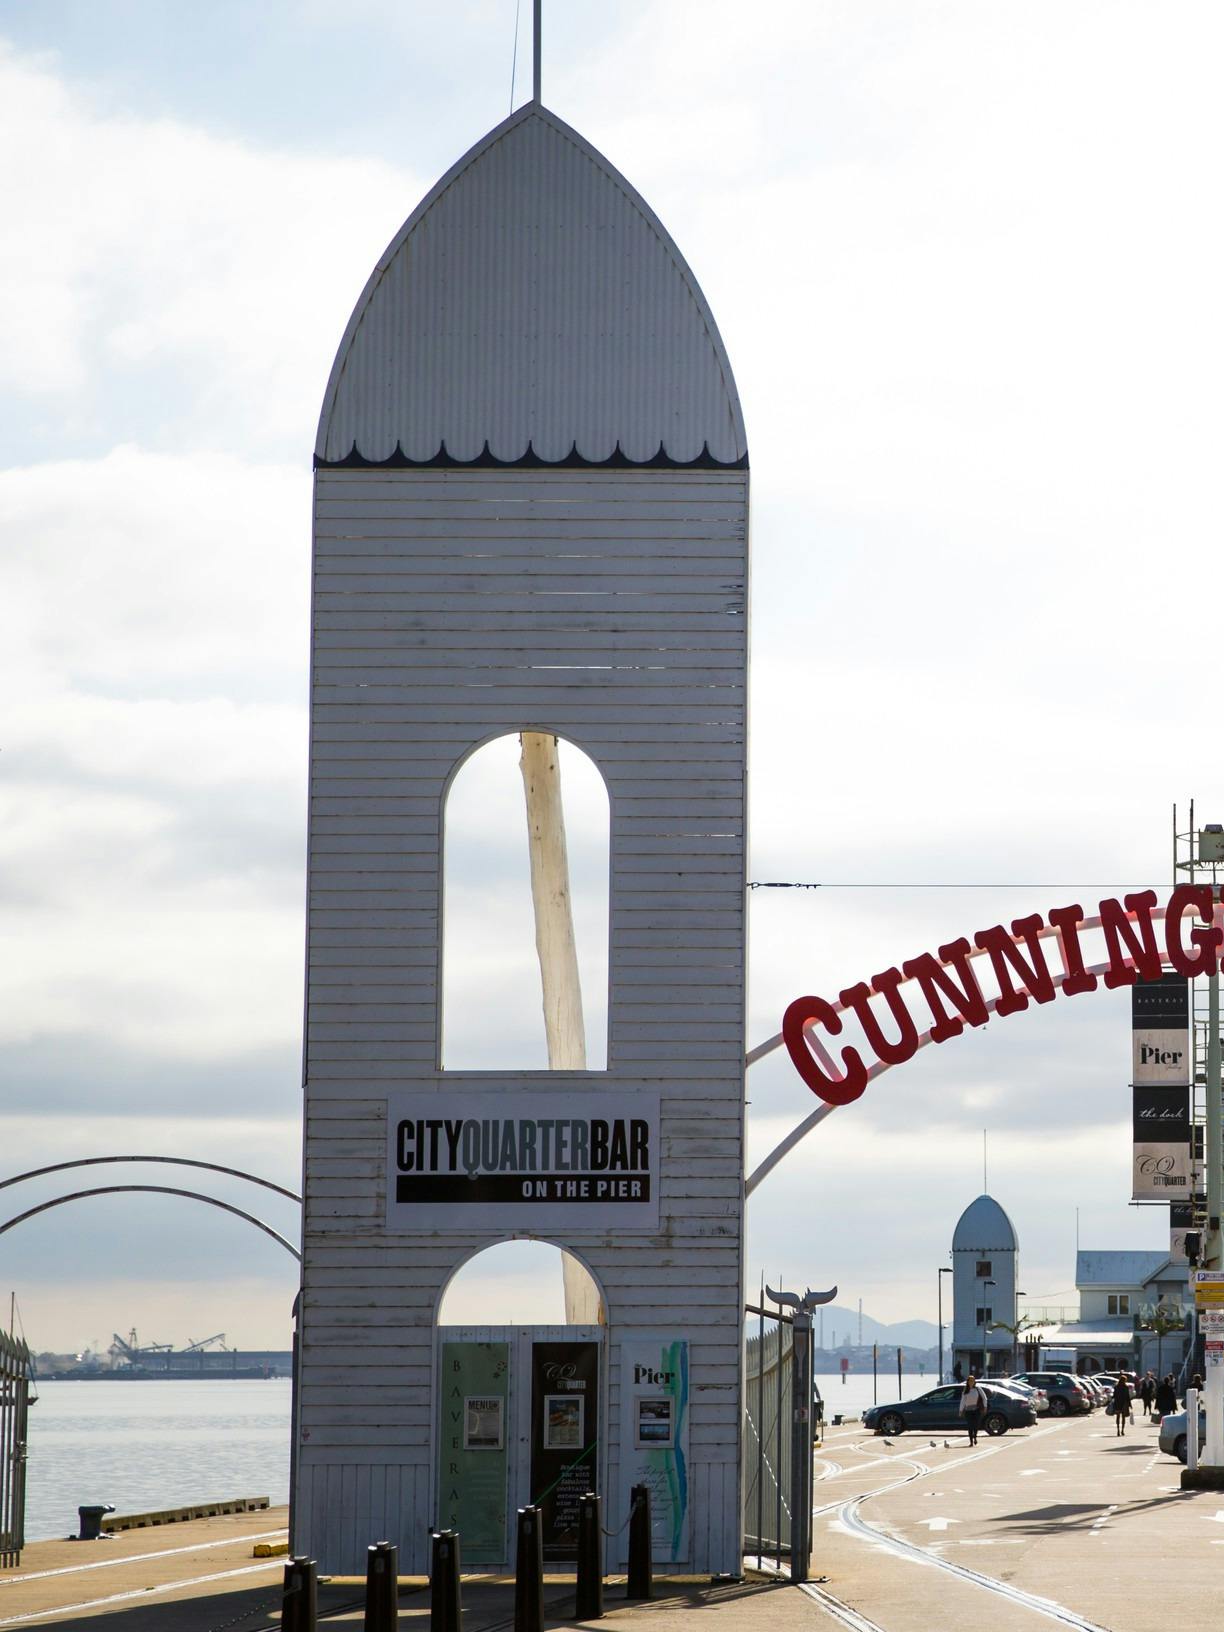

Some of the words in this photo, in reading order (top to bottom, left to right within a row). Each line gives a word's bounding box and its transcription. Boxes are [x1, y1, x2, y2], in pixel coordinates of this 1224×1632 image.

[1141, 1047, 1182, 1065] Pier
[1139, 1107, 1157, 1118] the
[1159, 1105, 1184, 1118] dock
[1136, 1154, 1175, 1177] CQ
[522, 1181, 547, 1197] ON
[555, 1181, 589, 1197] THE
[597, 1181, 641, 1197] PIER
[633, 1367, 676, 1385] Pier
[469, 1400, 491, 1411] MENU
[449, 1360, 461, 1526] BAVERAS
